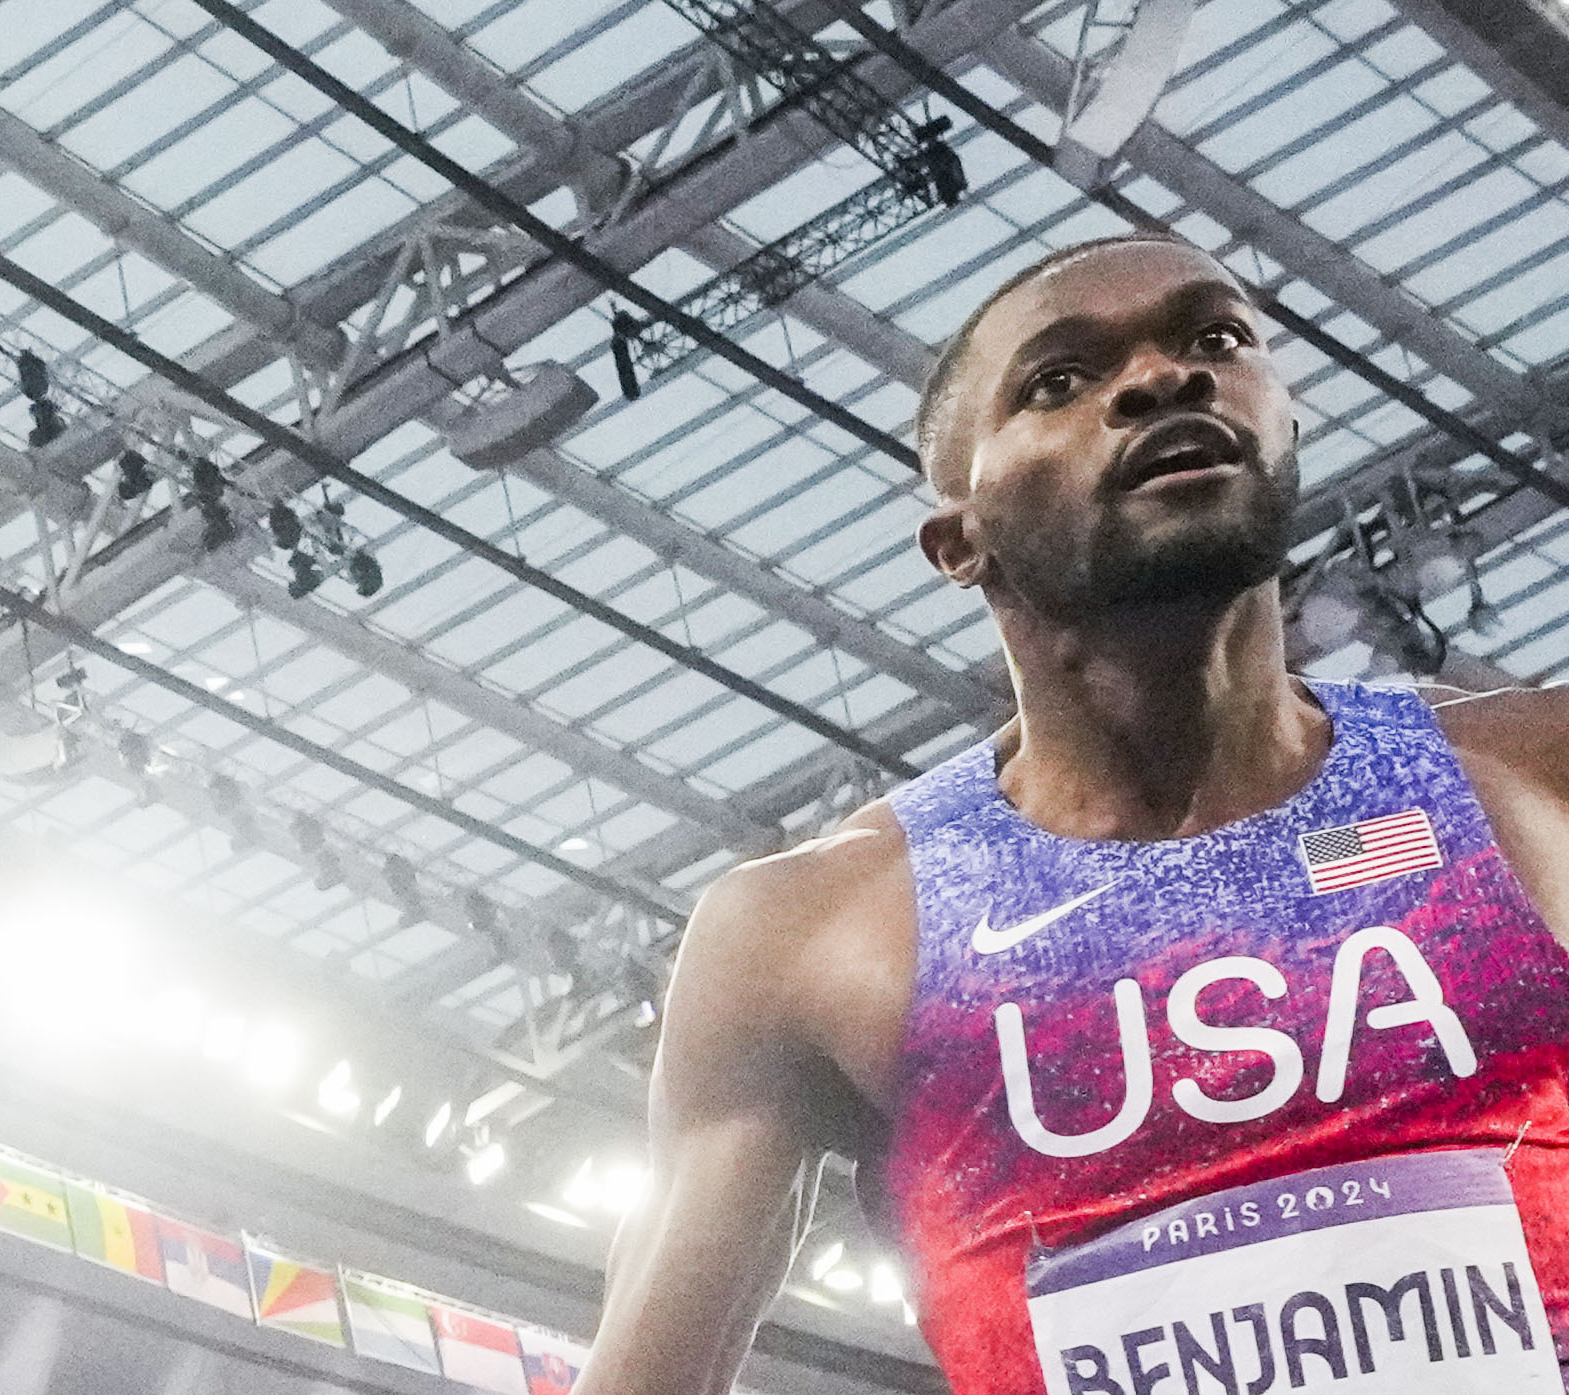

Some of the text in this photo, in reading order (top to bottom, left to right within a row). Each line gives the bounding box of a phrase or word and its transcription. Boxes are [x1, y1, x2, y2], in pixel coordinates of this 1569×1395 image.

[995, 926, 1477, 1158] USA
[1141, 1178, 1392, 1252] PARIS 2024
